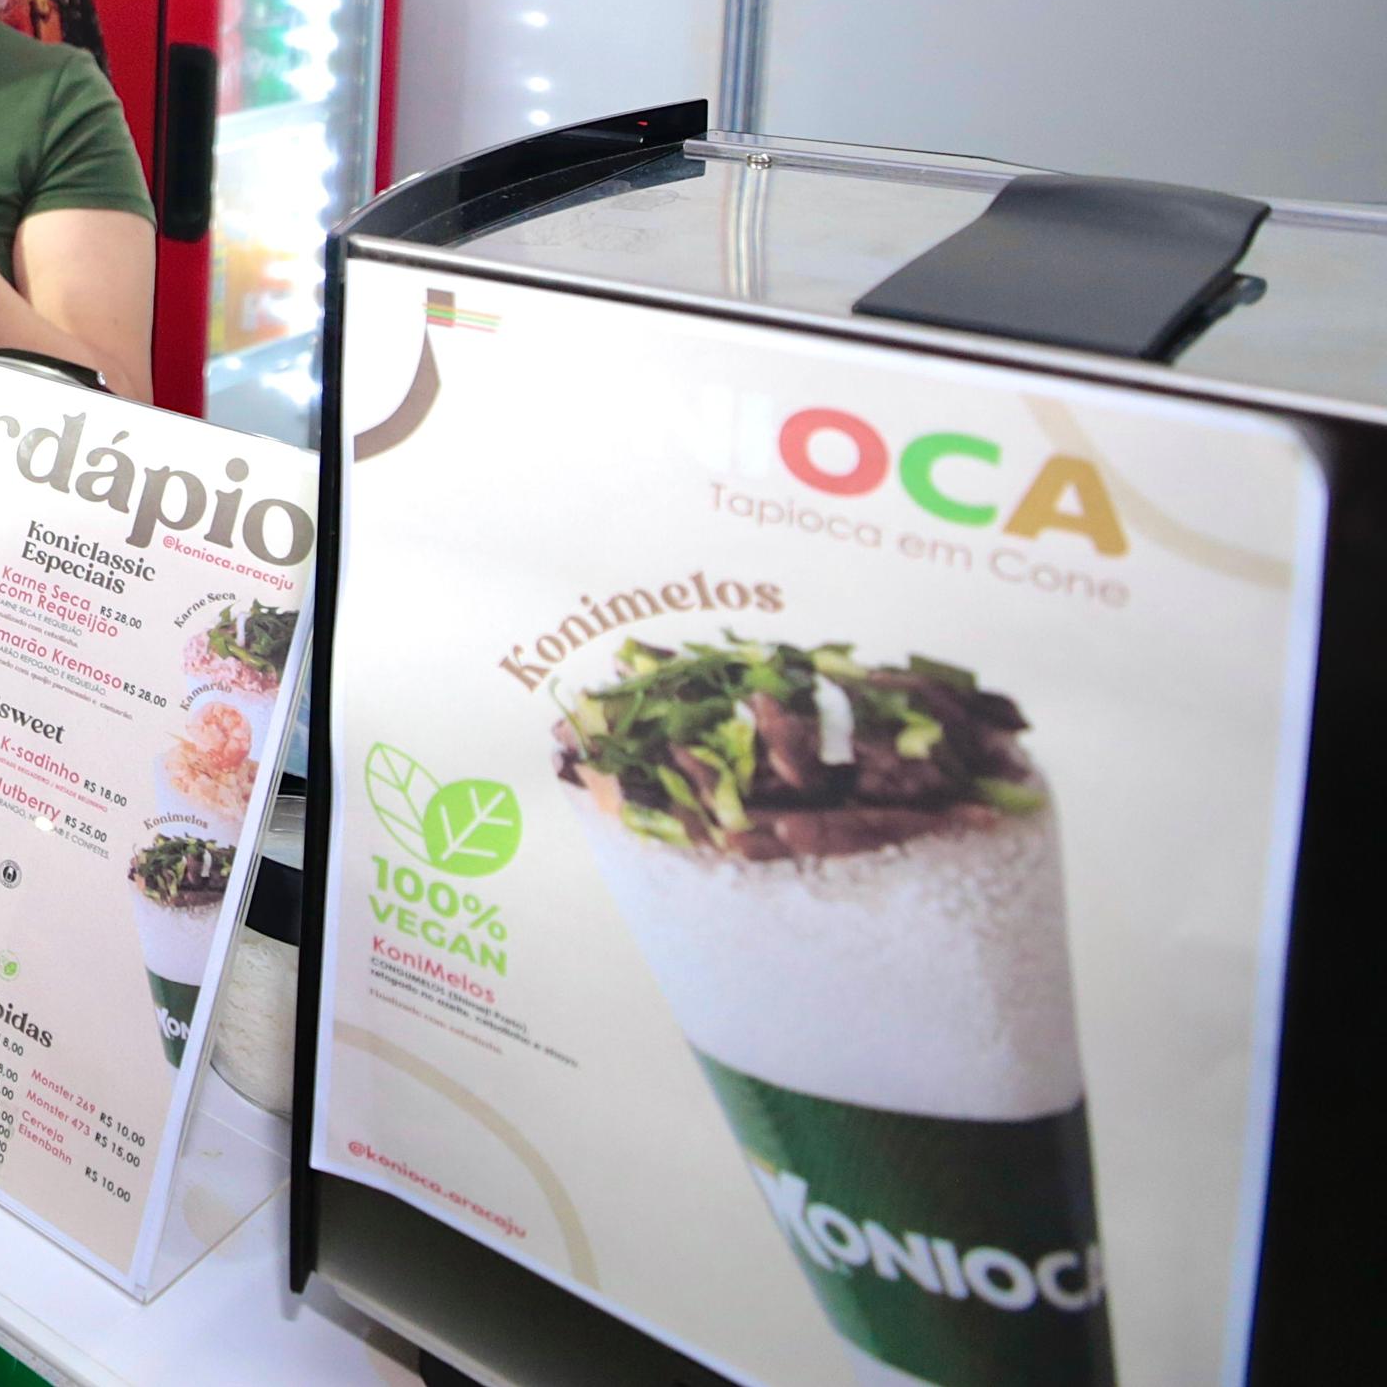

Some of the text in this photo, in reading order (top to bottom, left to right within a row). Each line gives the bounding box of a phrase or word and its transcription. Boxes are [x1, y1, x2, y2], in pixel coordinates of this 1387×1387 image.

[21, 541, 125, 594] Especiais
[27, 520, 156, 581] Koniclassic
[163, 535, 294, 591] @konioca.aracaju
[709, 481, 1130, 607] Tapioca em Cone
[1, 565, 91, 612] Karne Seca
[37, 595, 118, 638] Requeijão
[100, 606, 112, 619] R$
[114, 612, 142, 629] 28,00
[174, 593, 236, 629] Karne Seca
[499, 570, 786, 693] Konimelos
[52, 648, 123, 689] Kremoso
[123, 682, 135, 695] R$
[137, 689, 167, 708] 28,00
[0, 736, 127, 807] K-sadinho R$ 18,00
[65, 815, 77, 828] R$
[79, 823, 107, 843] 25,00
[143, 813, 209, 831] Konimelos
[368, 854, 508, 942] 100%
[368, 894, 508, 978] VEGAN
[372, 936, 495, 1003] KoniMelos
[3, 1036, 24, 1056] 8,00
[22, 1110, 65, 1144] Cerveja
[27, 1090, 141, 1168] Monster 473 R$ 15,00
[31, 1069, 146, 1147] Monster 269 R$ 10,00
[18, 1124, 131, 1203] Eisenbahn R$ 10,00
[348, 1141, 527, 1239] @konioca.aracaju
